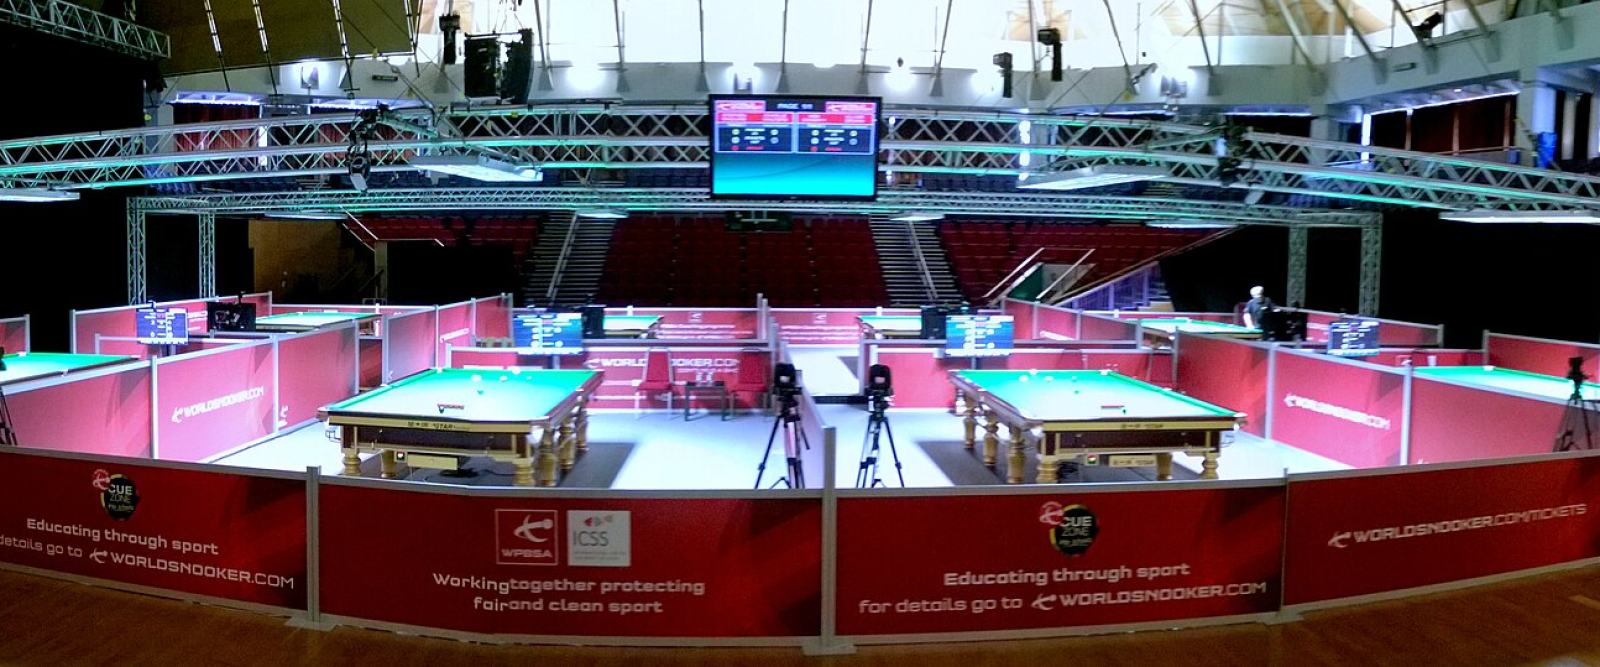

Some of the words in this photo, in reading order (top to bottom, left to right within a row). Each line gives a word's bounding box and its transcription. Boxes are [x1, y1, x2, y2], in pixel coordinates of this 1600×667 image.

[108, 484, 133, 495] CUE
[1060, 516, 1093, 527] CUE
[26, 518, 101, 542] Educating
[104, 528, 168, 550] through
[171, 539, 220, 555] sport
[573, 530, 609, 547] ICSS
[501, 549, 553, 558] WPBSA
[46, 543, 64, 556] go
[67, 545, 83, 558] to
[110, 551, 295, 590] WORLDSNOOKER.COM
[943, 569, 1048, 586] Educating
[1052, 565, 1132, 583] through
[1136, 563, 1191, 581] sport
[600, 579, 706, 595] protecting
[858, 599, 892, 614] for
[895, 597, 968, 613] details
[970, 599, 997, 614] go
[1001, 597, 1023, 610] to
[1059, 582, 1267, 607] WORLDSNOOKER.COM
[548, 598, 604, 612] clean
[608, 601, 664, 616] sport
